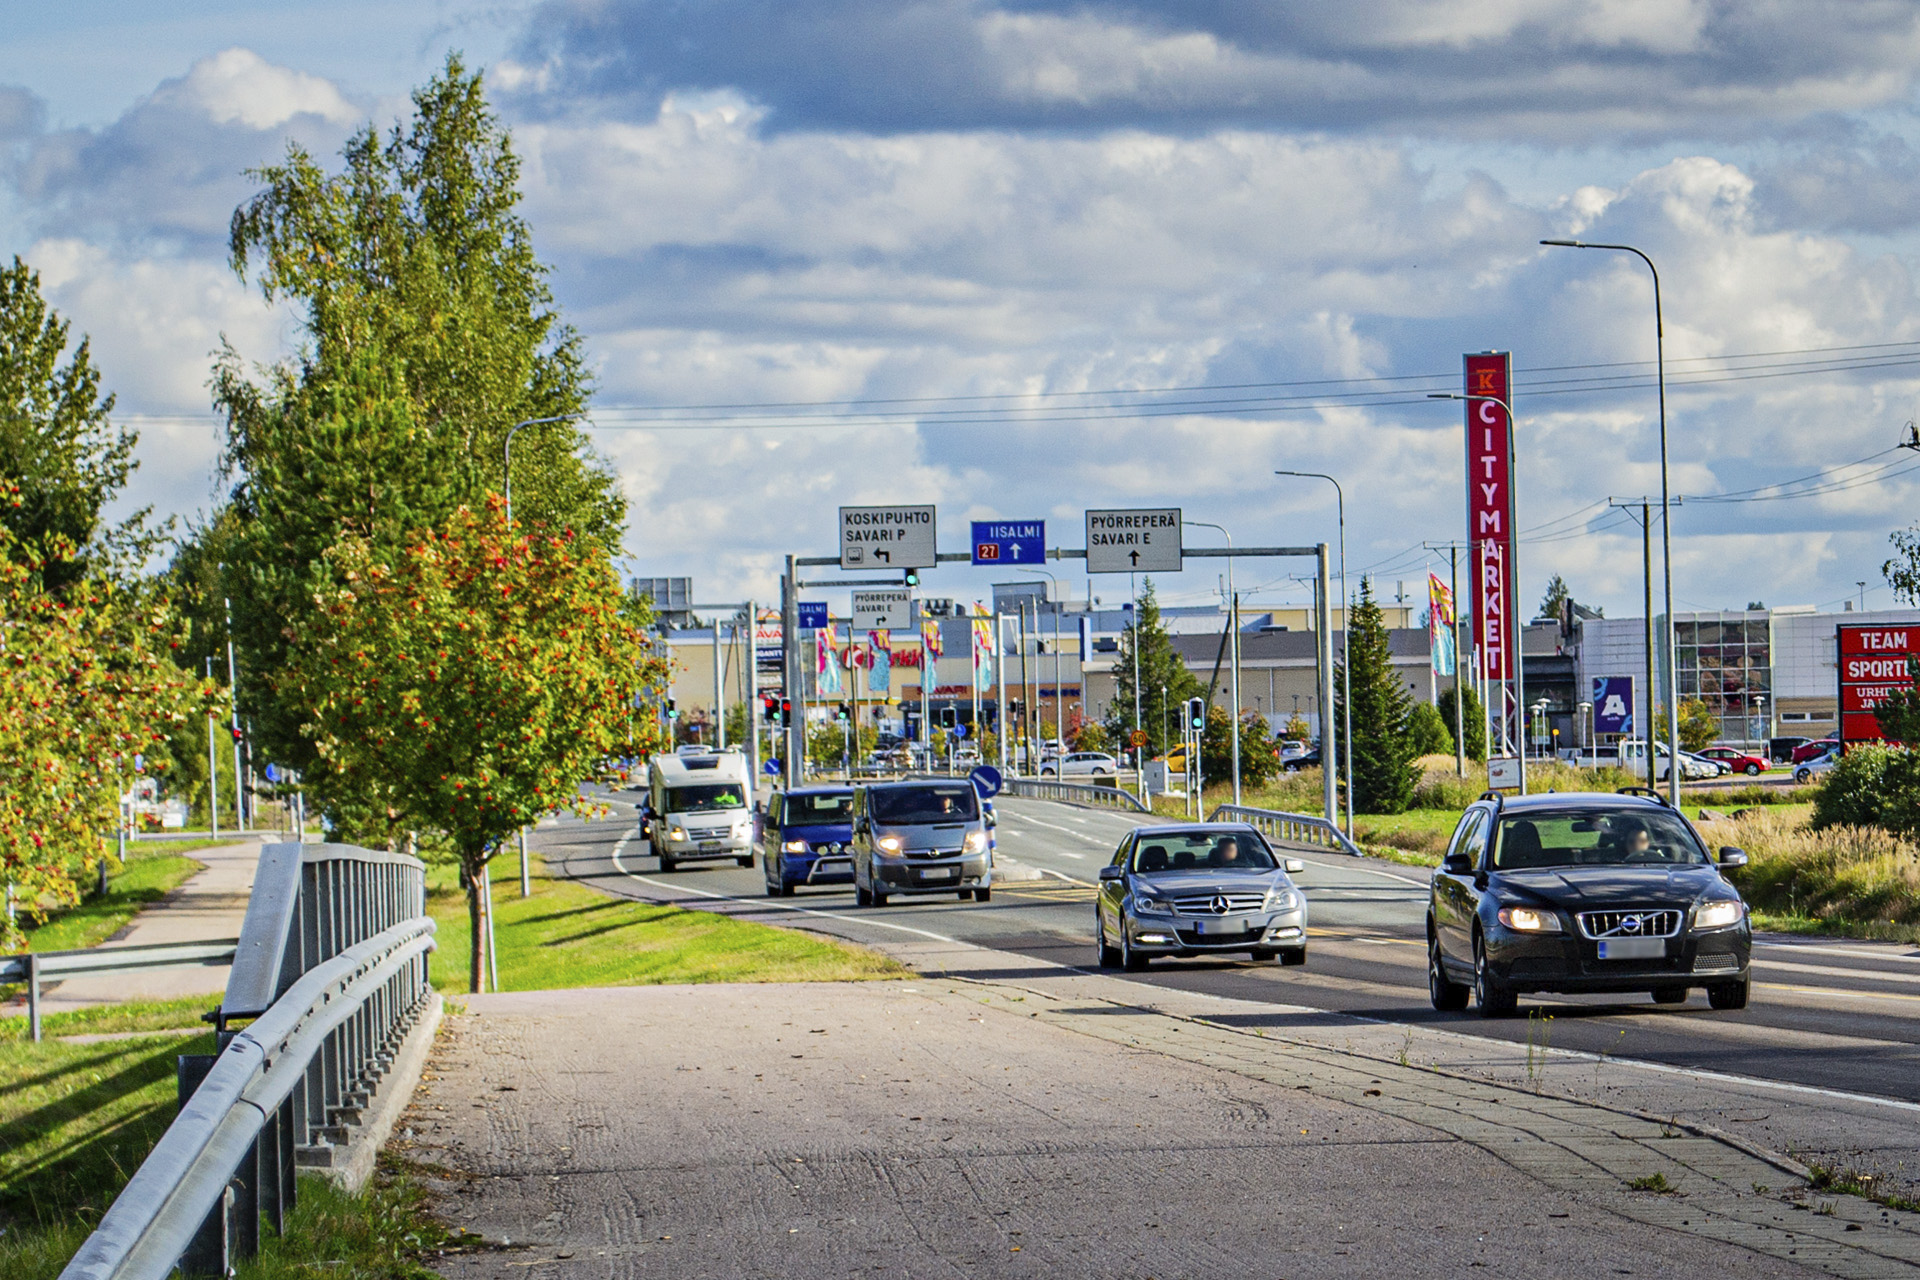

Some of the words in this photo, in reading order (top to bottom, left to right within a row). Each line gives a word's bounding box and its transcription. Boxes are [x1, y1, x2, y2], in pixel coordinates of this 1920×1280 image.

[845, 512, 930, 525] KOSKIPUHTO
[1091, 513, 1175, 528] PYÖRREPERÄ
[846, 529, 892, 541] SAVARI
[897, 529, 905, 540] P
[990, 526, 1039, 538] IISALMI
[1479, 401, 1501, 669] CITYMARKET
[1092, 533, 1138, 545] SAVARI
[1143, 533, 1150, 544] E
[981, 545, 995, 557] 27
[855, 593, 907, 602] PYÖRREPERÄ
[800, 604, 826, 614] SALMI
[855, 604, 884, 612] SAVARI
[887, 604, 892, 612] E
[1860, 632, 1907, 649] TEAM
